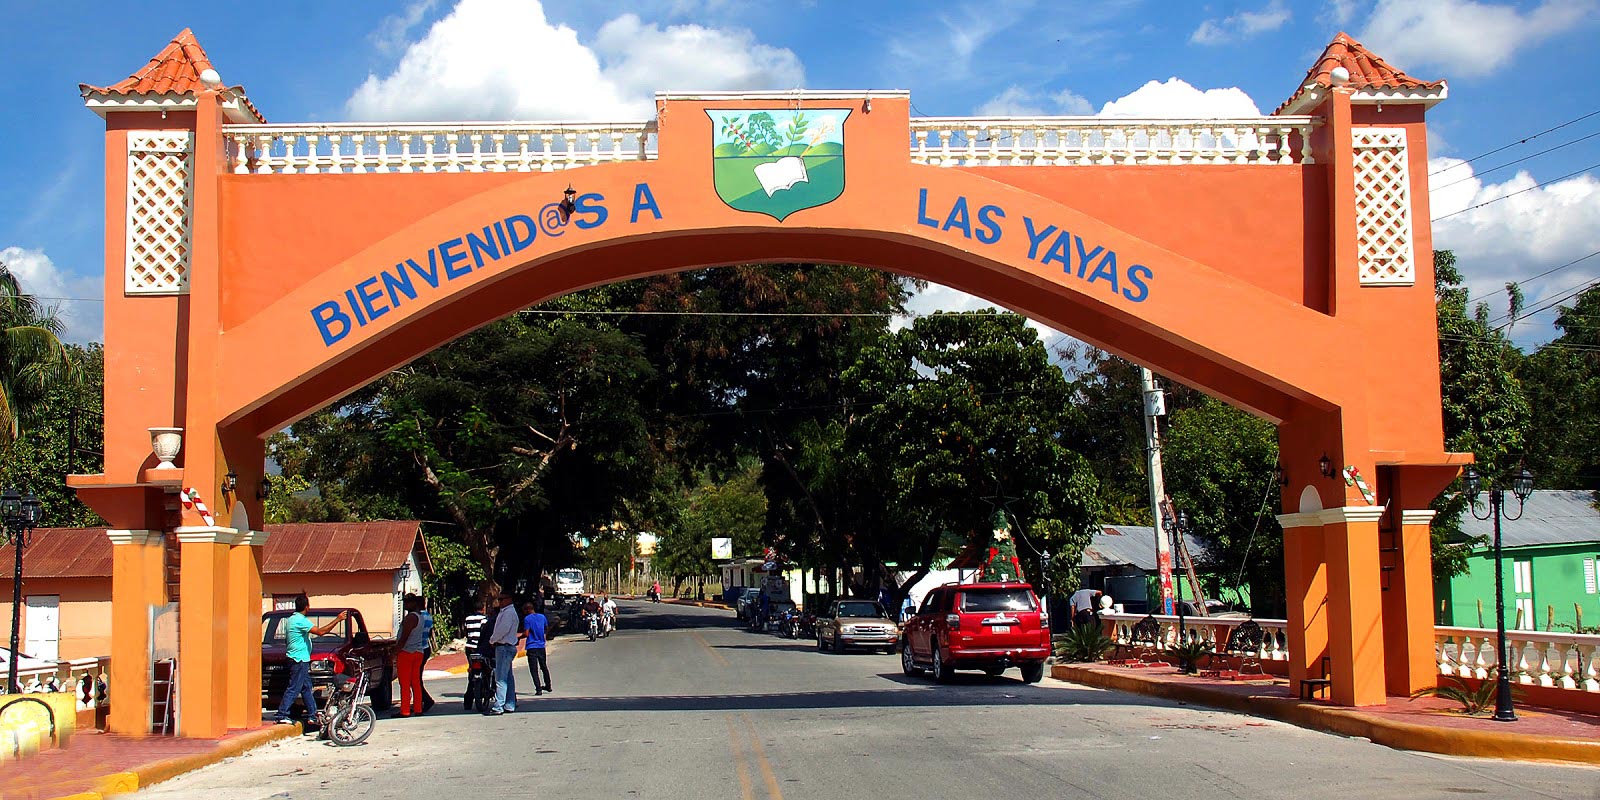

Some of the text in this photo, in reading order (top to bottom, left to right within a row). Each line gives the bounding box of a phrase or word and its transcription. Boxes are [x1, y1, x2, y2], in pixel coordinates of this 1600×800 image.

[311, 183, 1153, 347] BIENVENID@S A LAS YAYAS
